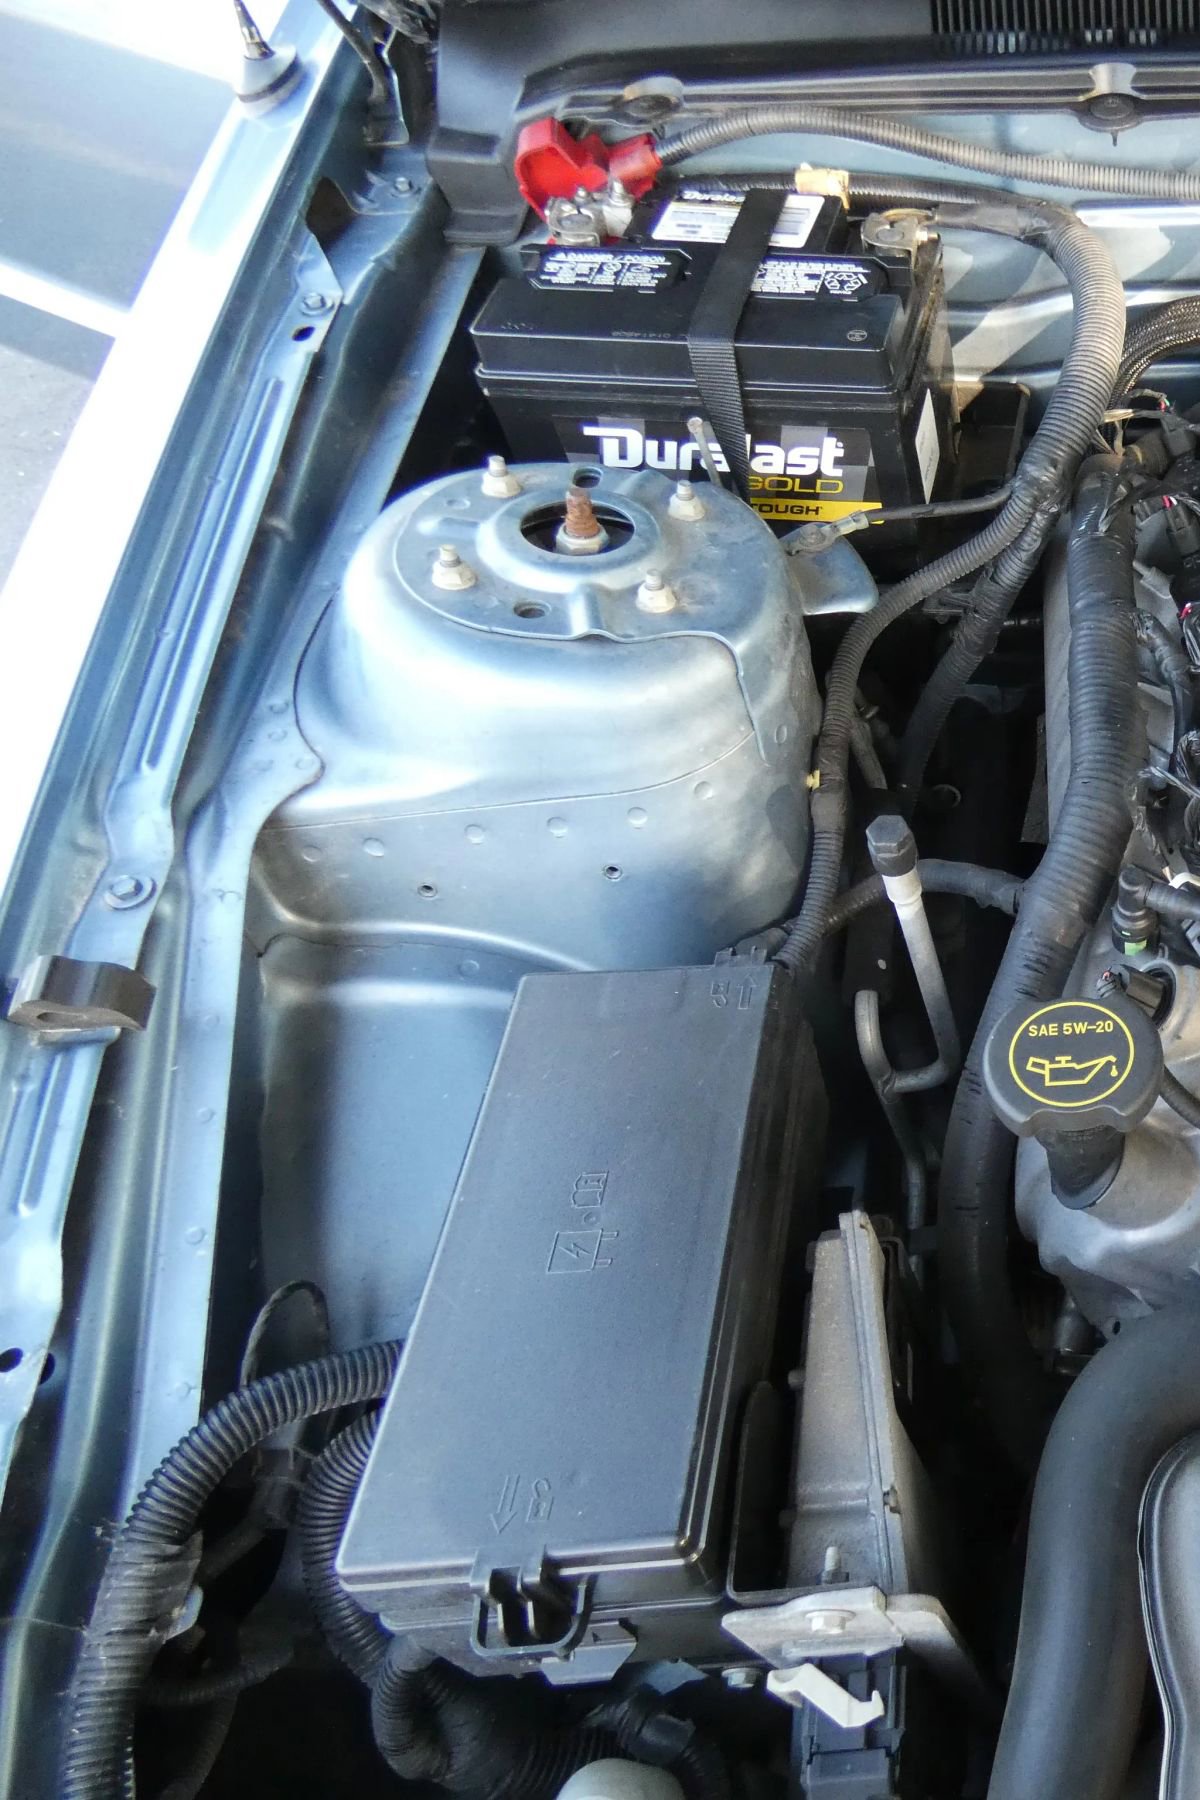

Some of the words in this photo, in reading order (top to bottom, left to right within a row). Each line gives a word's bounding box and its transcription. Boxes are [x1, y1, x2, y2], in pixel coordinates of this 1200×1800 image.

[682, 190, 745, 202] Duralas
[583, 426, 845, 477] Duraast
[1028, 1023, 1059, 1037] SAE
[1062, 1020, 1114, 1035] 5W-20
